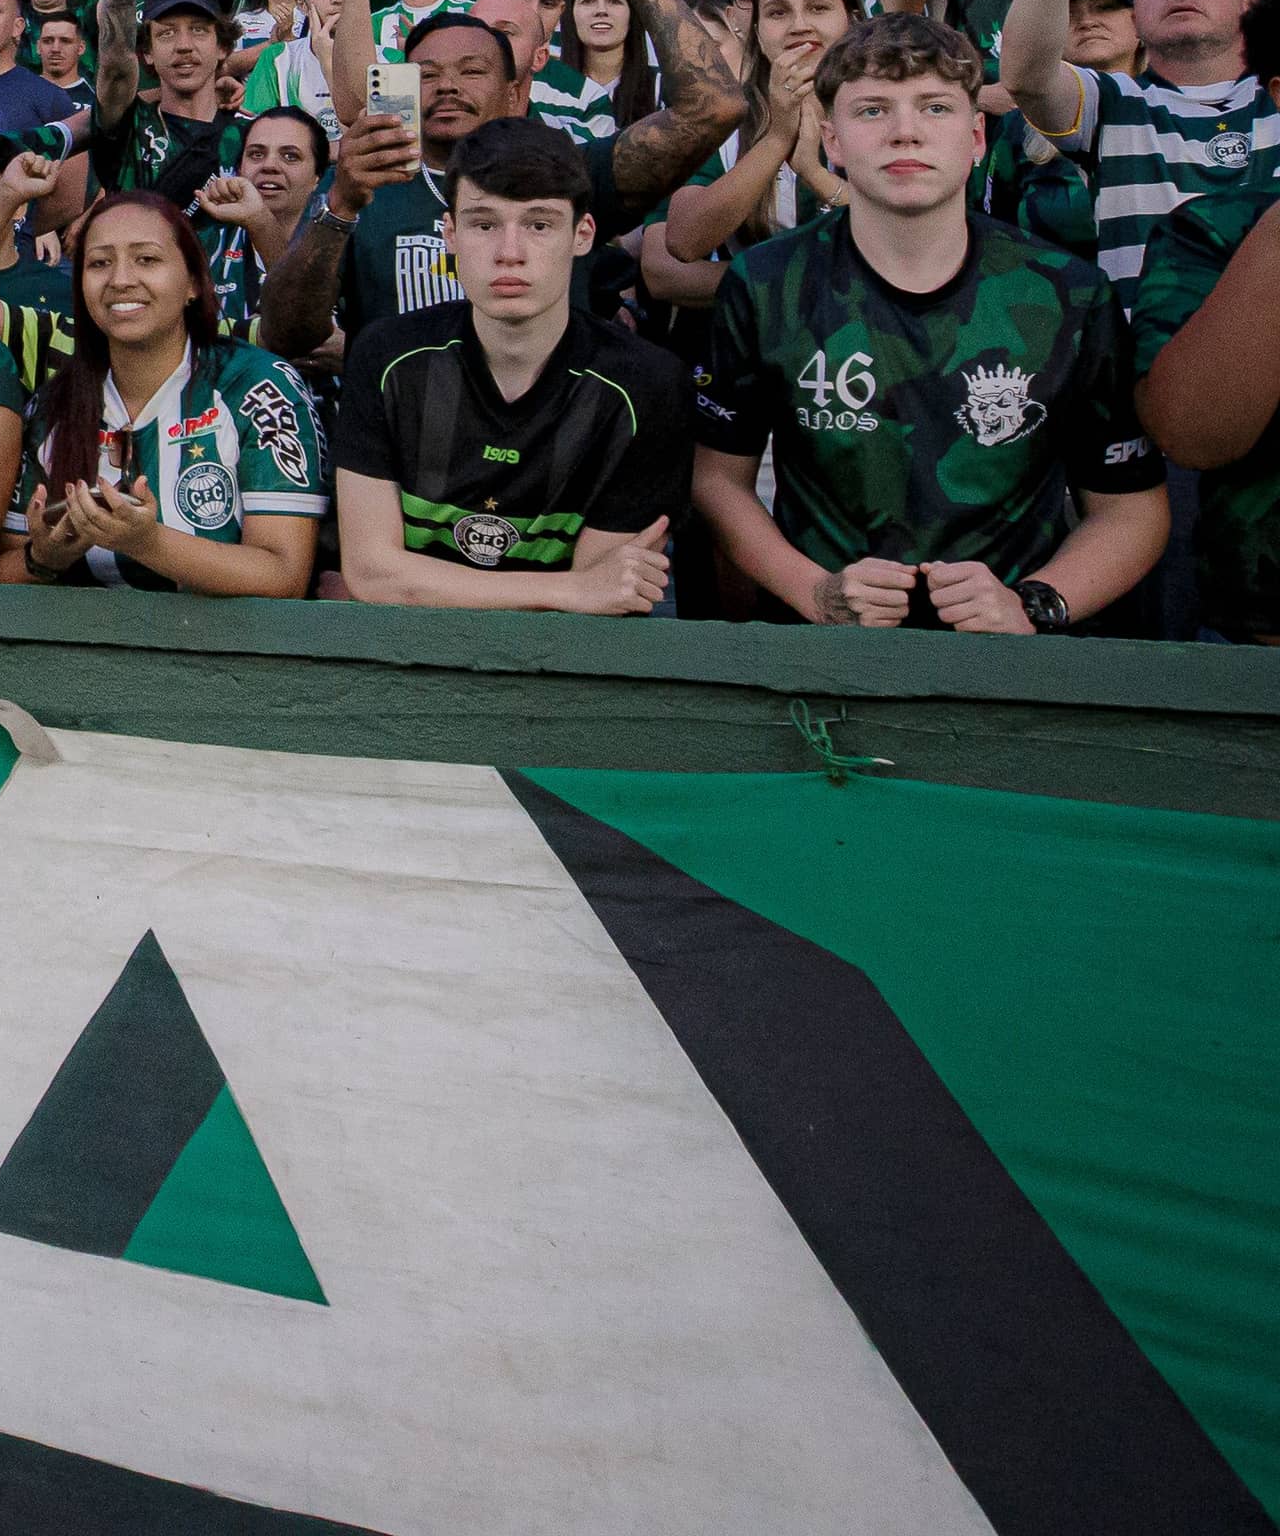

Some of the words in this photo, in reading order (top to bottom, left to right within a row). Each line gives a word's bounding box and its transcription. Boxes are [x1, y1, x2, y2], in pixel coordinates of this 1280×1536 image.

[1217, 143, 1245, 157] CFC
[797, 348, 878, 412] 46
[482, 444, 521, 464] 1909
[190, 487, 223, 507] CFC
[468, 531, 505, 548] CFC
